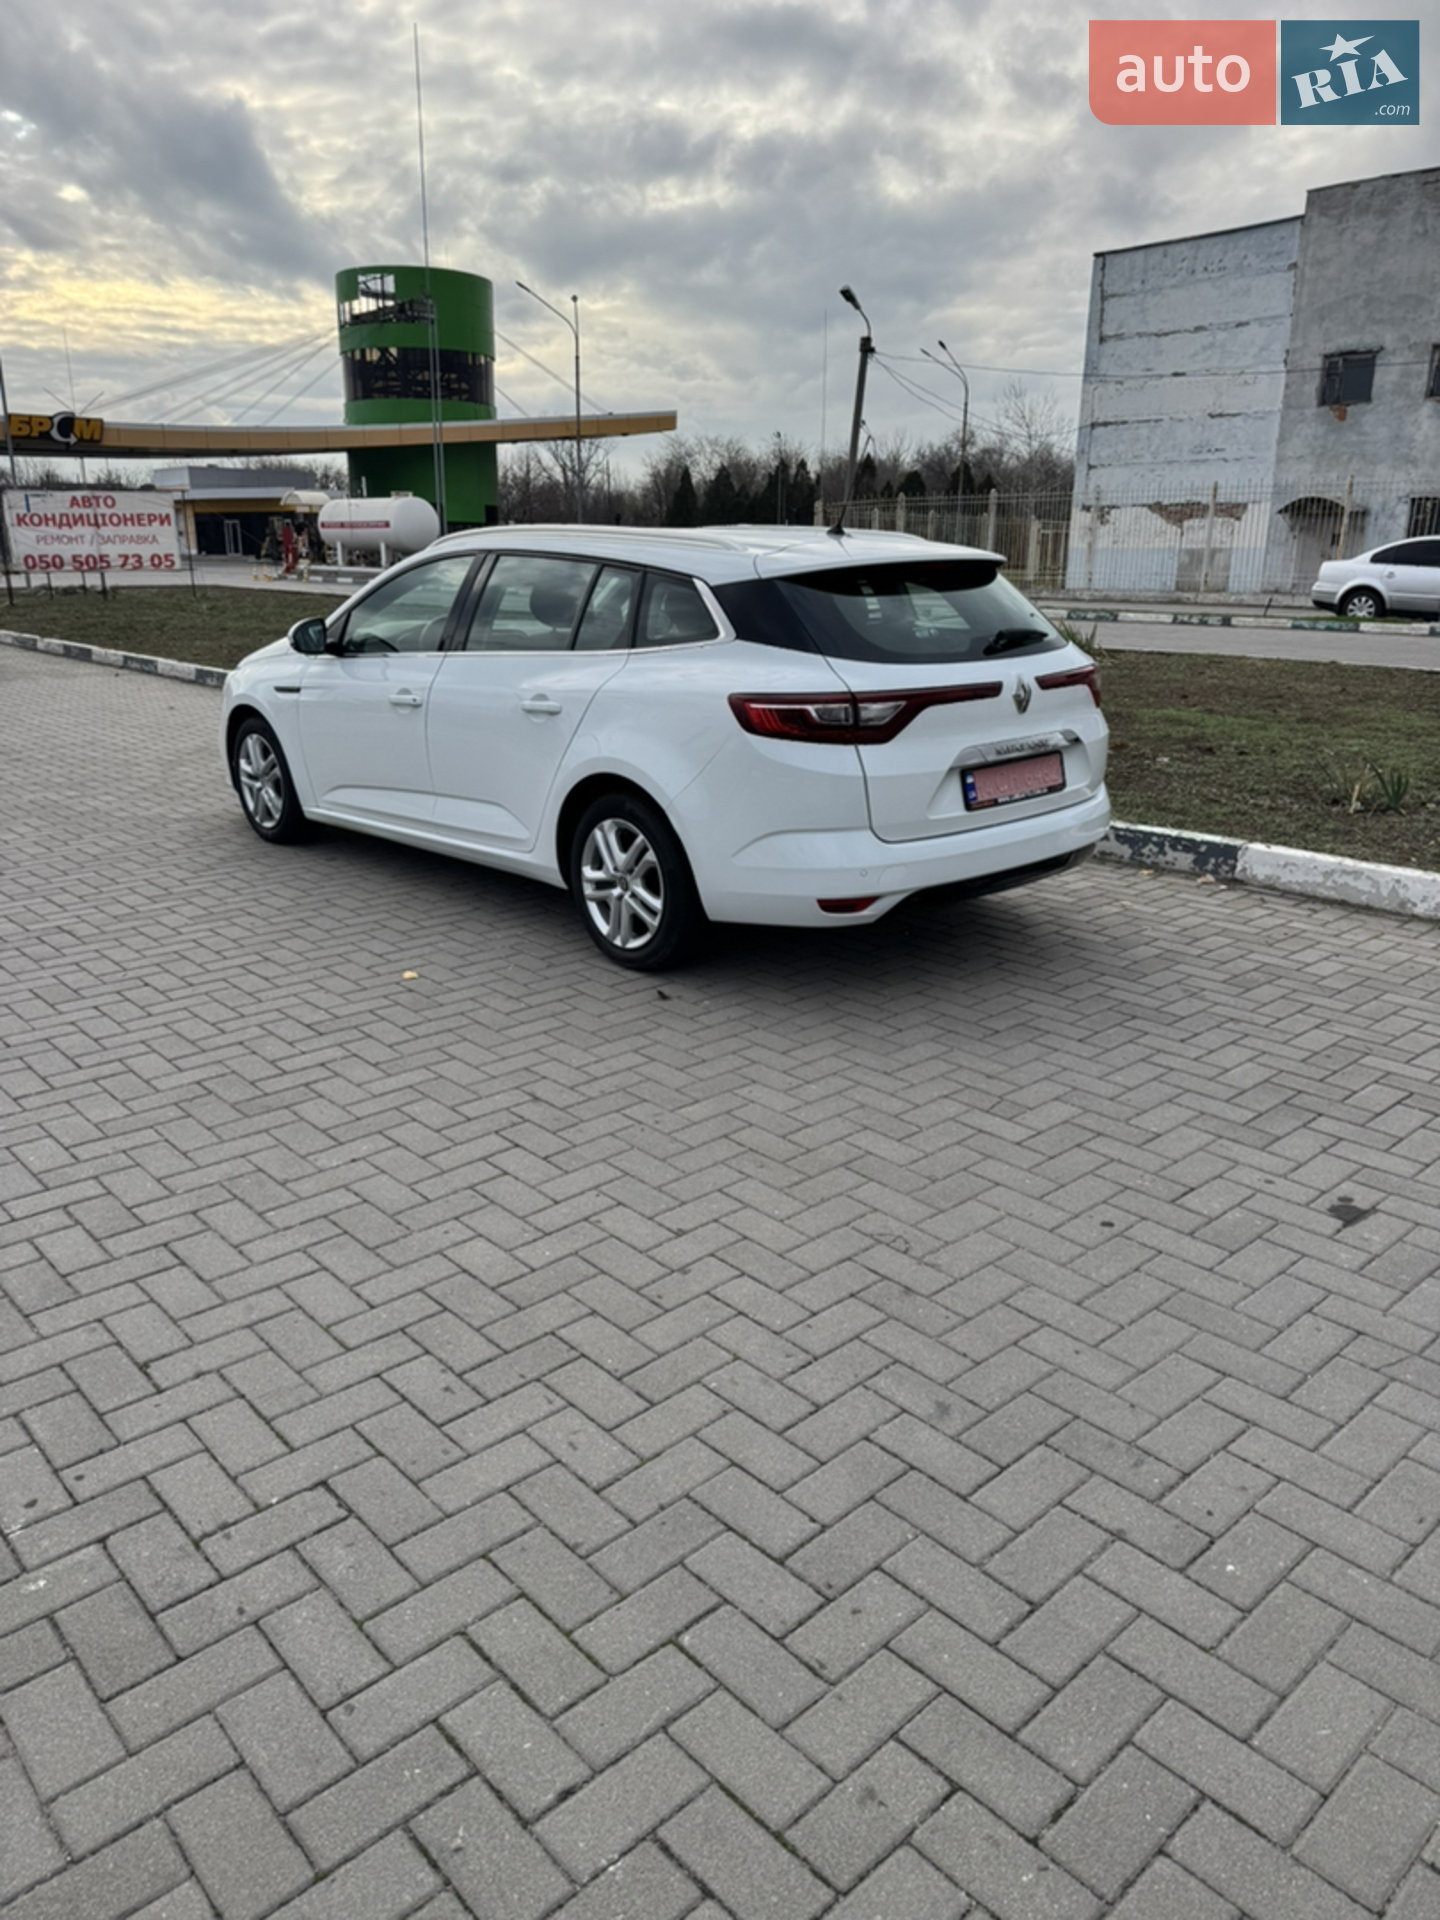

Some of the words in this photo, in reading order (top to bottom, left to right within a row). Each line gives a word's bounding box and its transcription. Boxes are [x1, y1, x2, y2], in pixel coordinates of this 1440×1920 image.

[69, 494, 117, 509] АВТО
[15, 512, 172, 530] КОНДИЦІОНЕРИ
[35, 534, 86, 545] РЕМОНТ
[99, 534, 159, 545] ЗАПРАВКА
[23, 554, 65, 570] 050
[71, 553, 111, 570] 505
[117, 553, 144, 570] 73
[149, 553, 176, 569] 05
